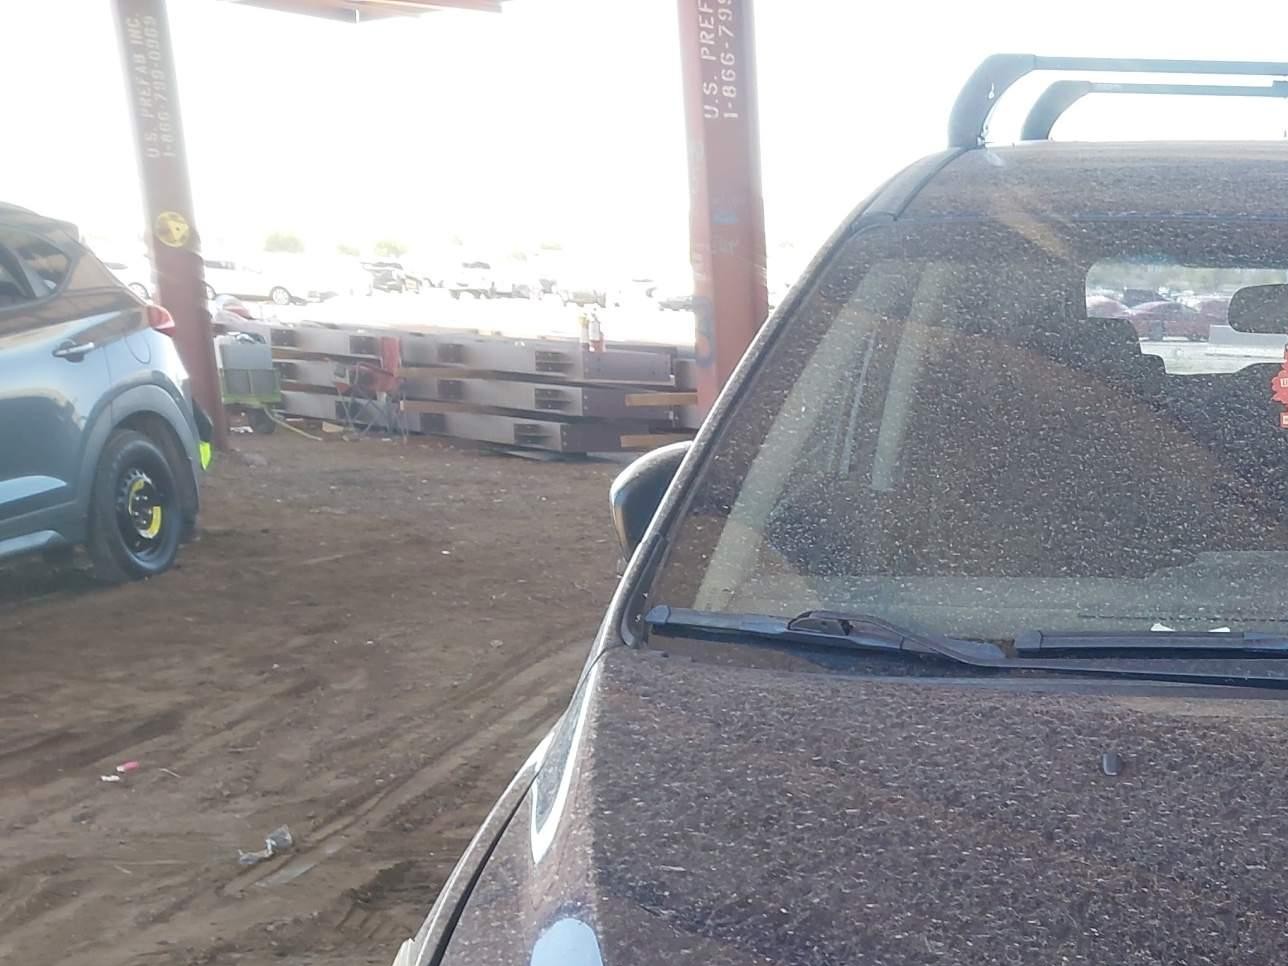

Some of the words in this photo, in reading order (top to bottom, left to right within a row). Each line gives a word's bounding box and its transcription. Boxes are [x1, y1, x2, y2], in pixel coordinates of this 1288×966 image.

[127, 13, 144, 45] INC.
[133, 54, 155, 119] PREFAB
[703, 75, 719, 119] U.S.
[145, 128, 160, 159] U.S.
